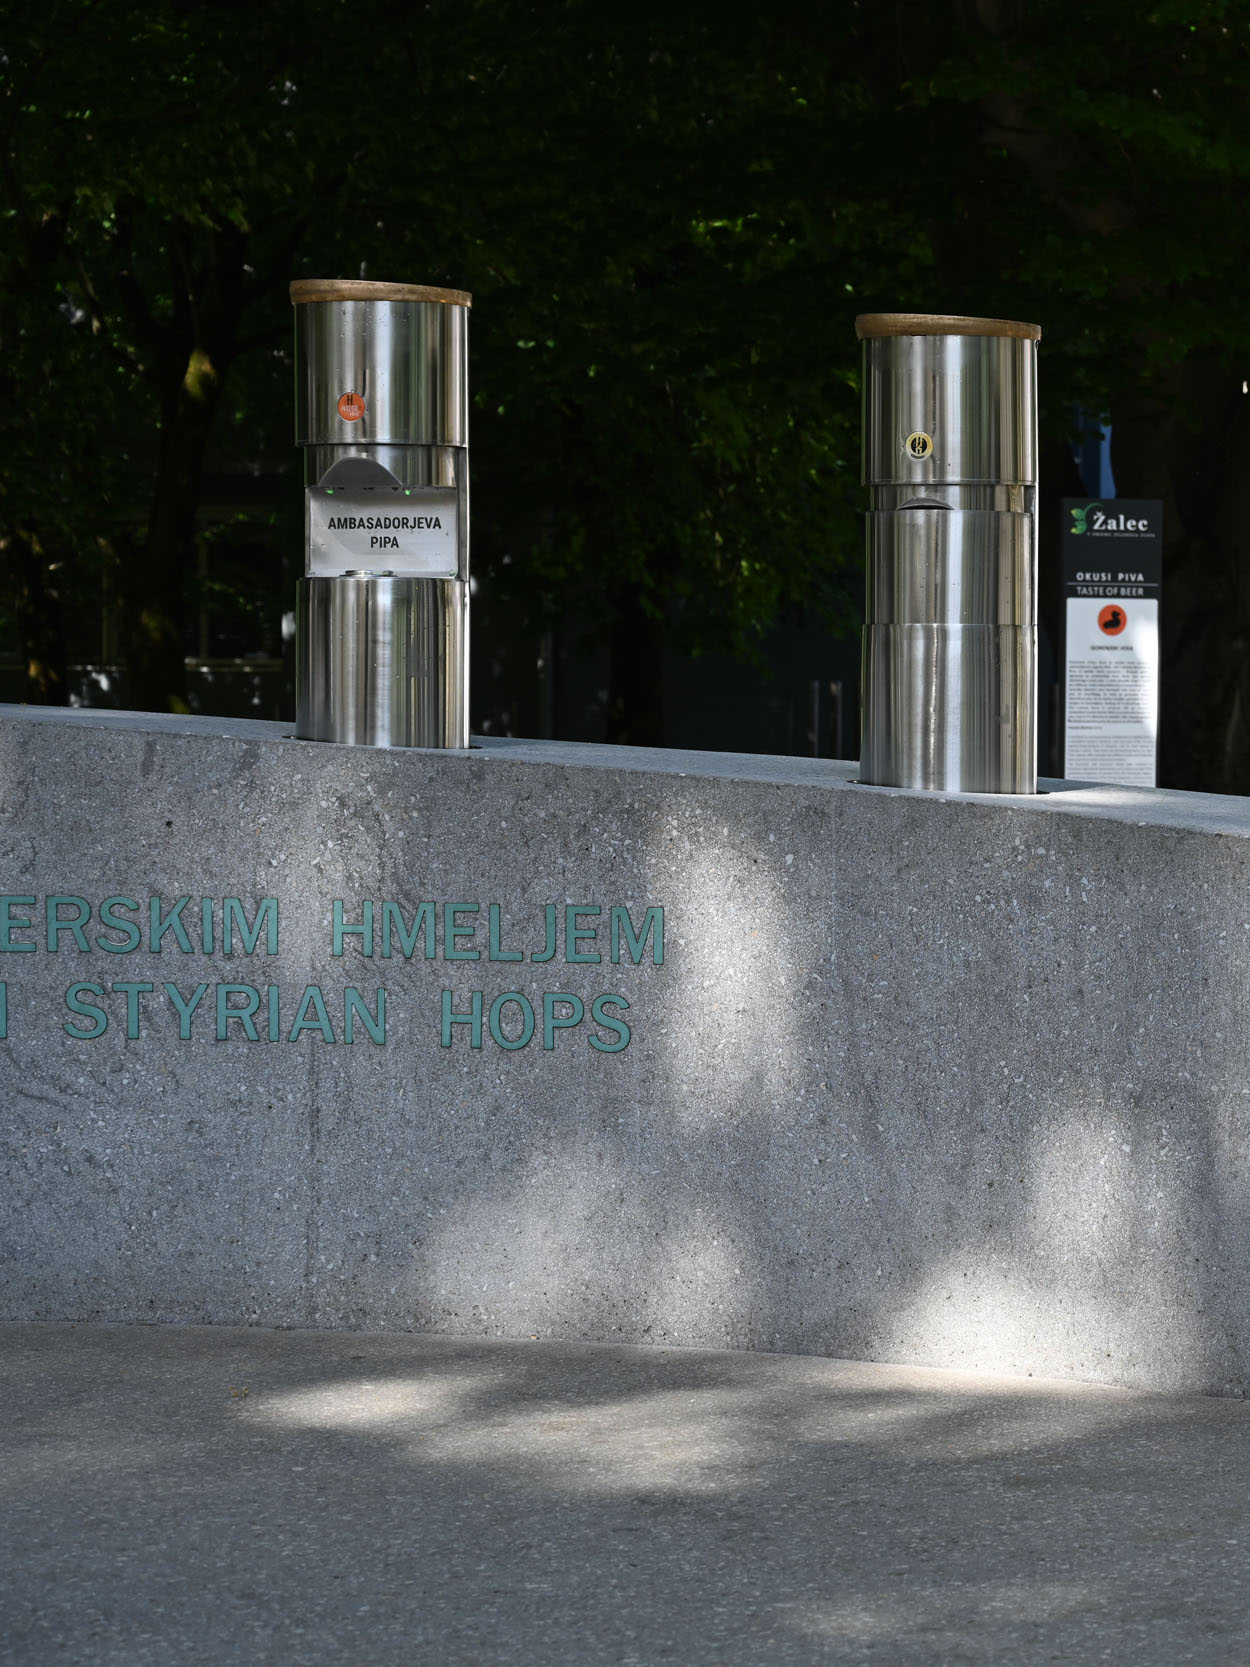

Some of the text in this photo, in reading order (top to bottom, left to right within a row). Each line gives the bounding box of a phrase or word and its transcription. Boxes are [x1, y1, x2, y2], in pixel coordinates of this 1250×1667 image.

[327, 517, 442, 530] AMBASADORJEVA
[1092, 511, 1148, 531] Žalec
[370, 536, 400, 549] PIPA
[1076, 571, 1145, 582] OKUSI PIVA
[1076, 586, 1144, 596] TASTE OF BEER
[0, 895, 665, 966] ERSKIM HMELJEM
[63, 981, 387, 1045] STYRIAN
[440, 989, 632, 1053] HOPS
